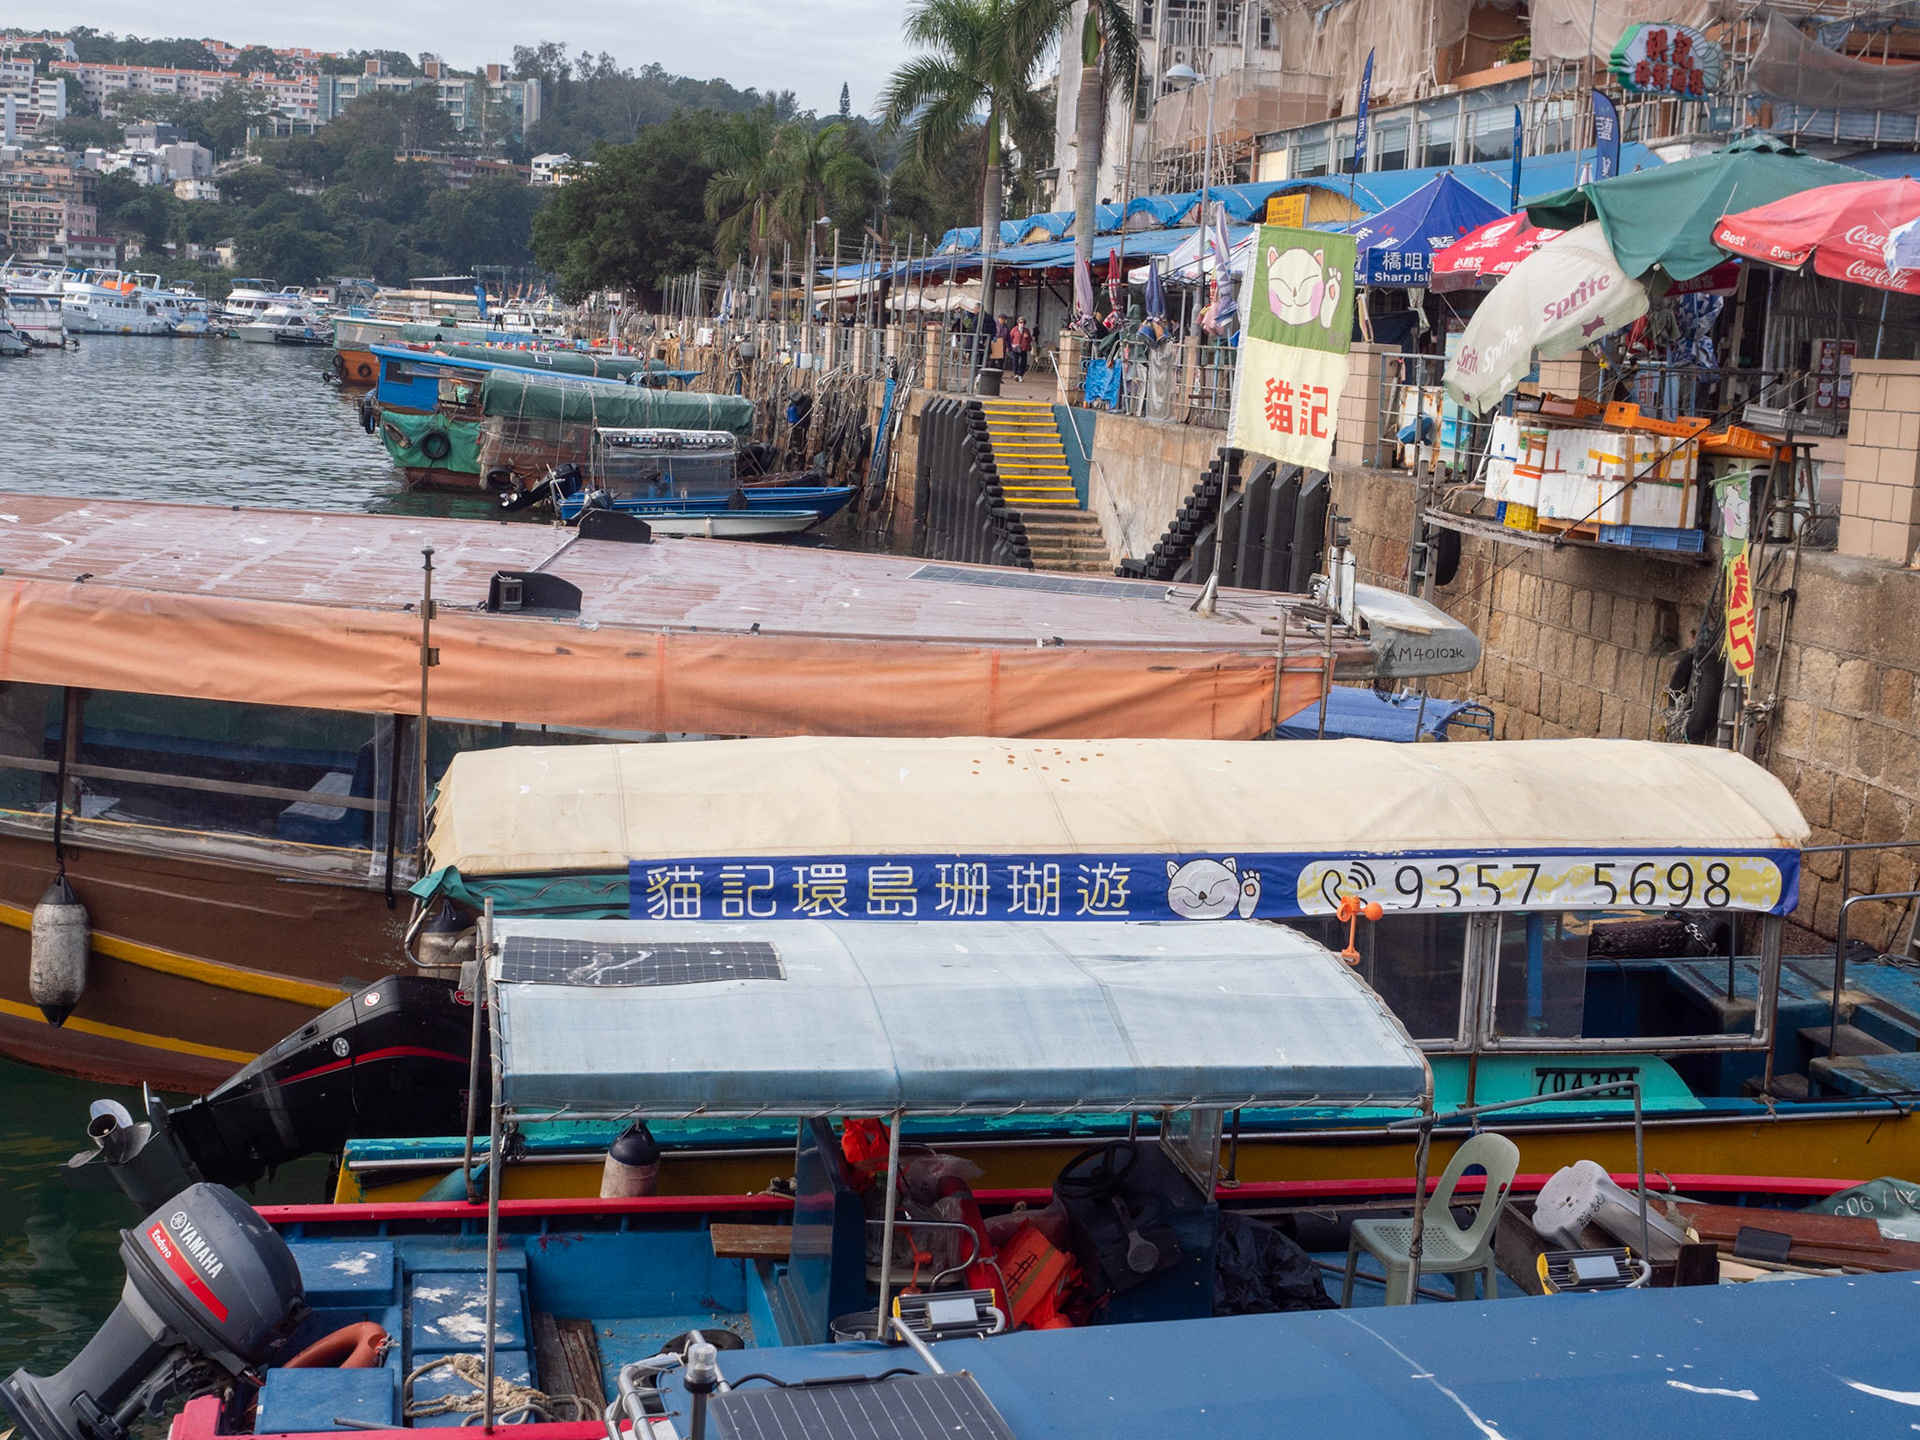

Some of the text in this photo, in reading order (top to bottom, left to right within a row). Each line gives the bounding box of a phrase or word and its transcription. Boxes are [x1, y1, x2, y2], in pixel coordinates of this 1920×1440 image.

[1382, 250, 1436, 270] 橋咀
[1720, 230, 1747, 247] Best
[1770, 245, 1805, 262] Ever?
[1374, 272, 1411, 283] Sharp
[1543, 274, 1611, 323] Sprite
[1482, 324, 1524, 374] Sprite
[1265, 377, 1329, 440] 貓記
[647, 861, 1131, 919] 貓記環島珊瑚遊
[1394, 862, 1731, 909] 9357 5698
[151, 1229, 172, 1259] Enduro
[179, 1222, 224, 1279] YAMAHA
